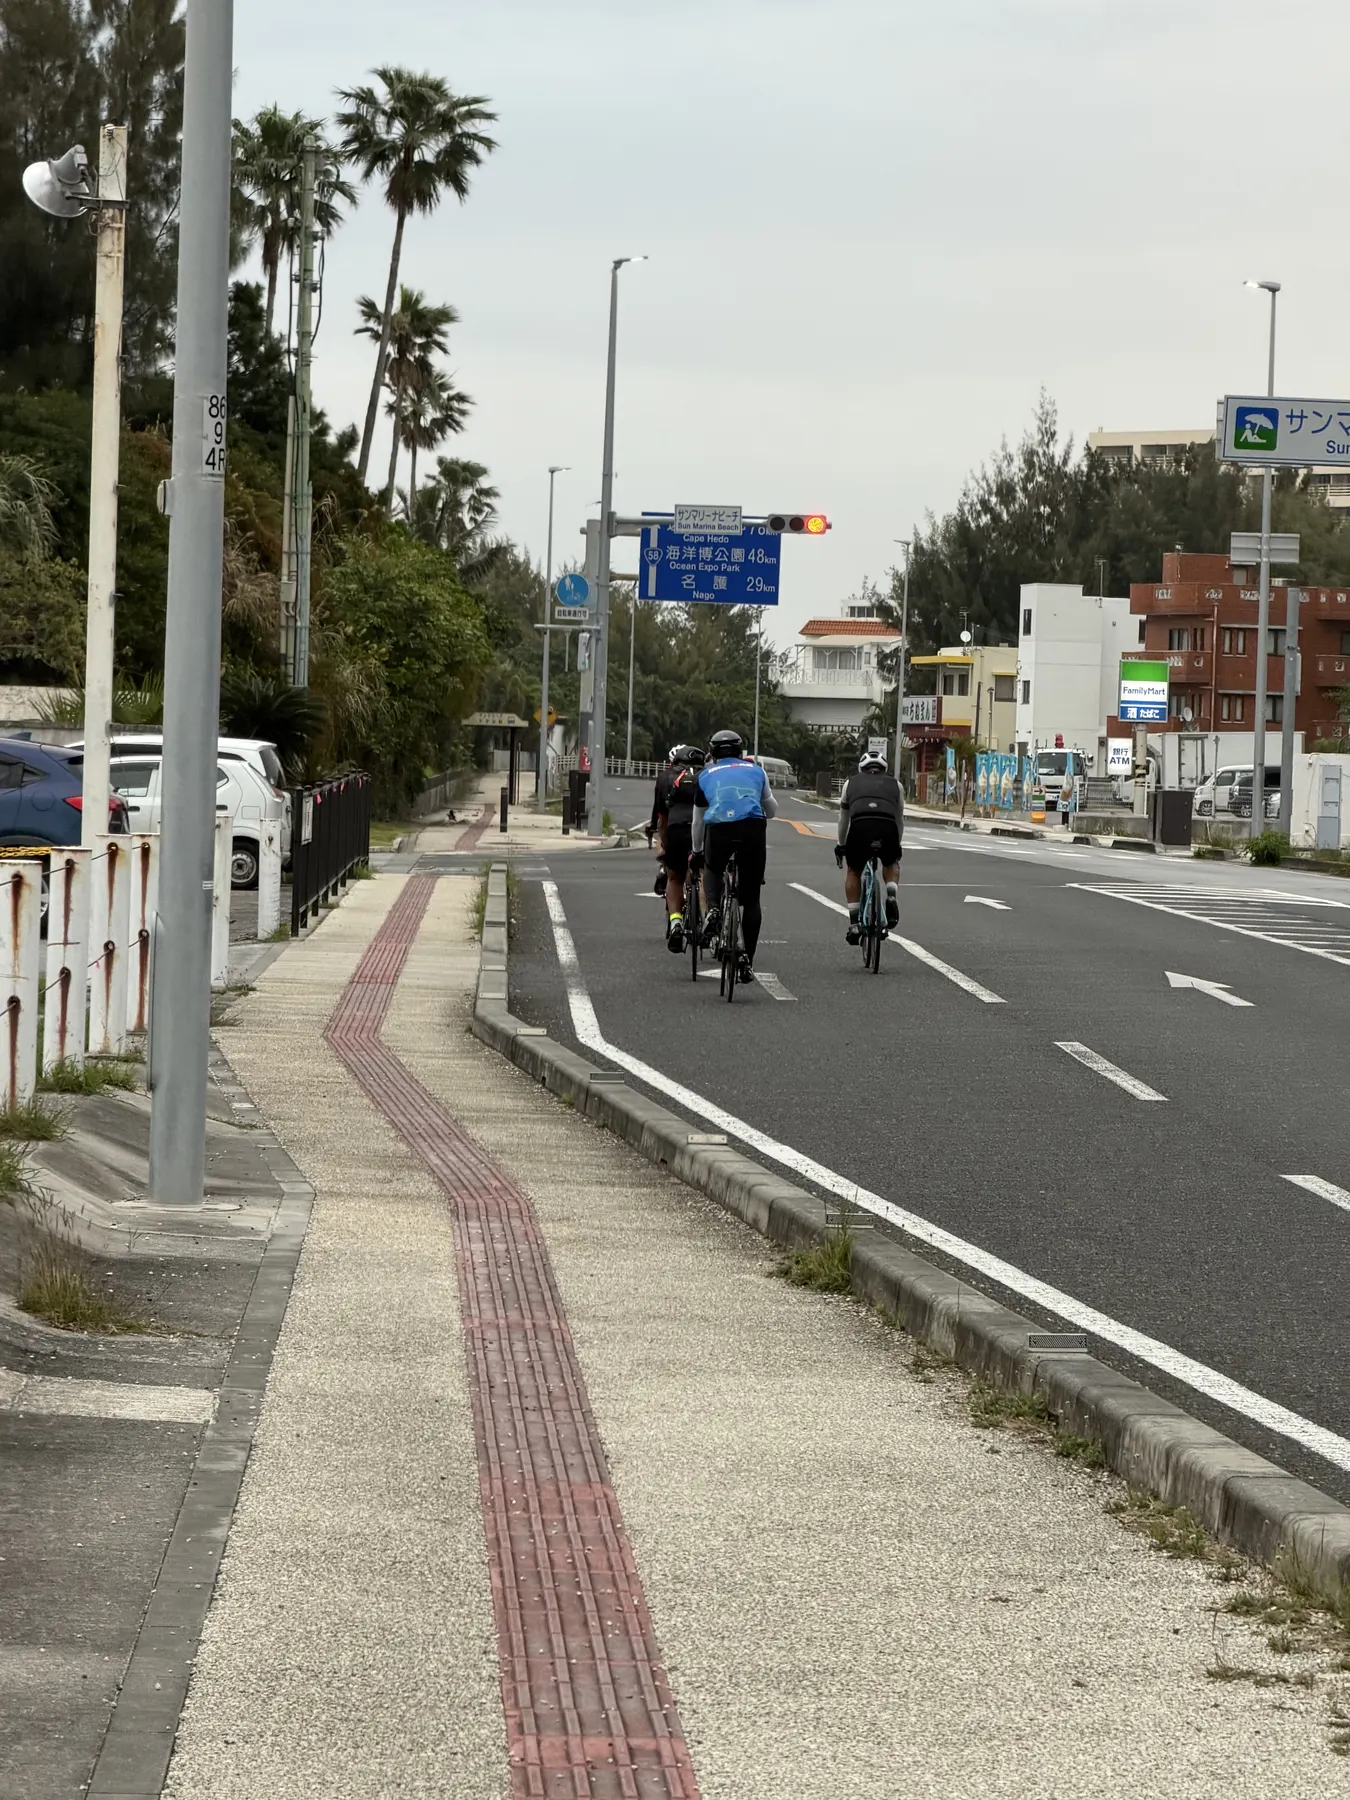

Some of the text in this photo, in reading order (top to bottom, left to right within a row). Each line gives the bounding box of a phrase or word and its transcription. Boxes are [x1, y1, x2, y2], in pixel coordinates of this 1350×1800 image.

[208, 394, 226, 419] 86
[214, 421, 223, 445] 9
[682, 533, 730, 544] Cape Hedo
[647, 550, 660, 561] 58
[665, 545, 777, 565] 海洋博公園 48km
[669, 561, 741, 573] Ocean Expo Park
[746, 576, 776, 593] 29km
[692, 590, 715, 601] Nago
[1122, 686, 1166, 696] FamilyMart
[1140, 709, 1160, 718] たばこ
[1112, 748, 1129, 756] 銀行
